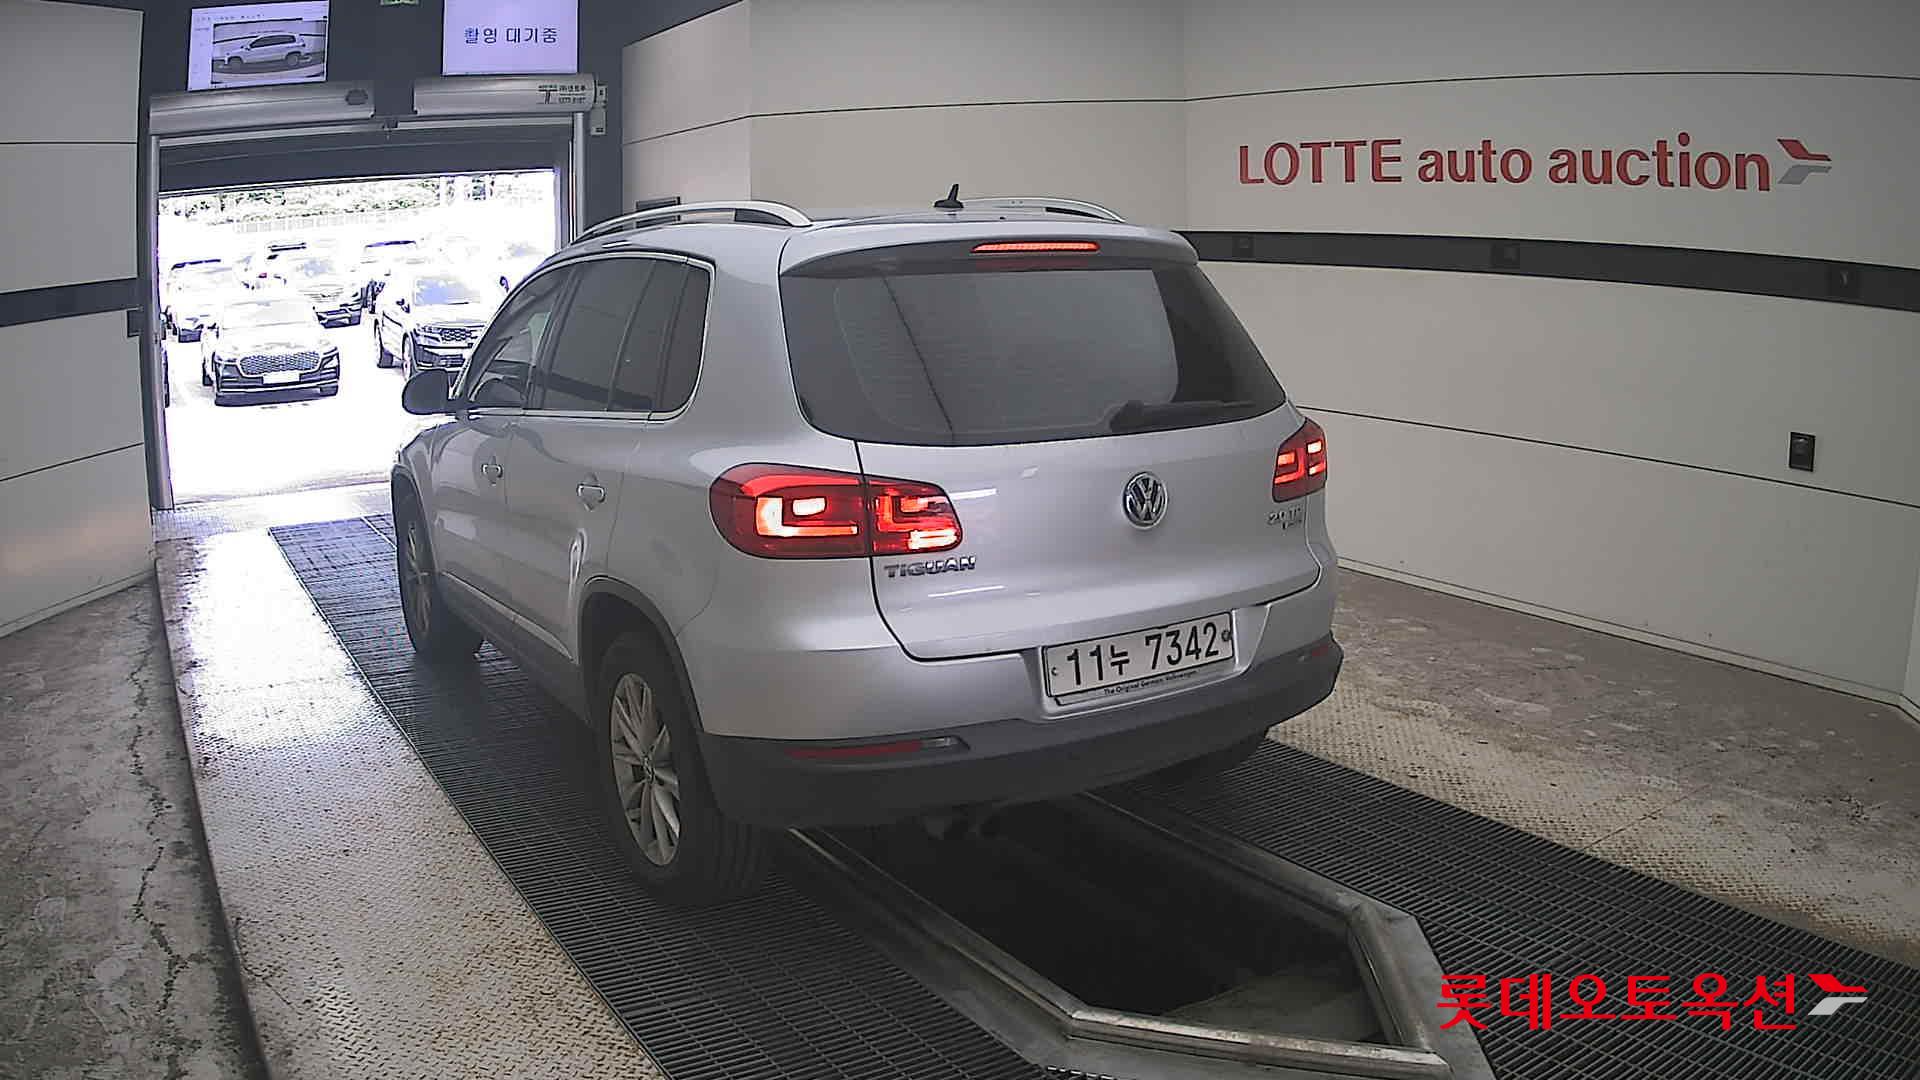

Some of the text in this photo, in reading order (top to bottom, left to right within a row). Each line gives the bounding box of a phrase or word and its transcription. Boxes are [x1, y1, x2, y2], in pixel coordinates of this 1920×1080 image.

[464, 27, 559, 44] 촬영 대기중
[1239, 132, 1770, 190] LOTTE auto auction
[884, 556, 977, 579] TIGUAN
[1066, 622, 1219, 686] 11누 7342
